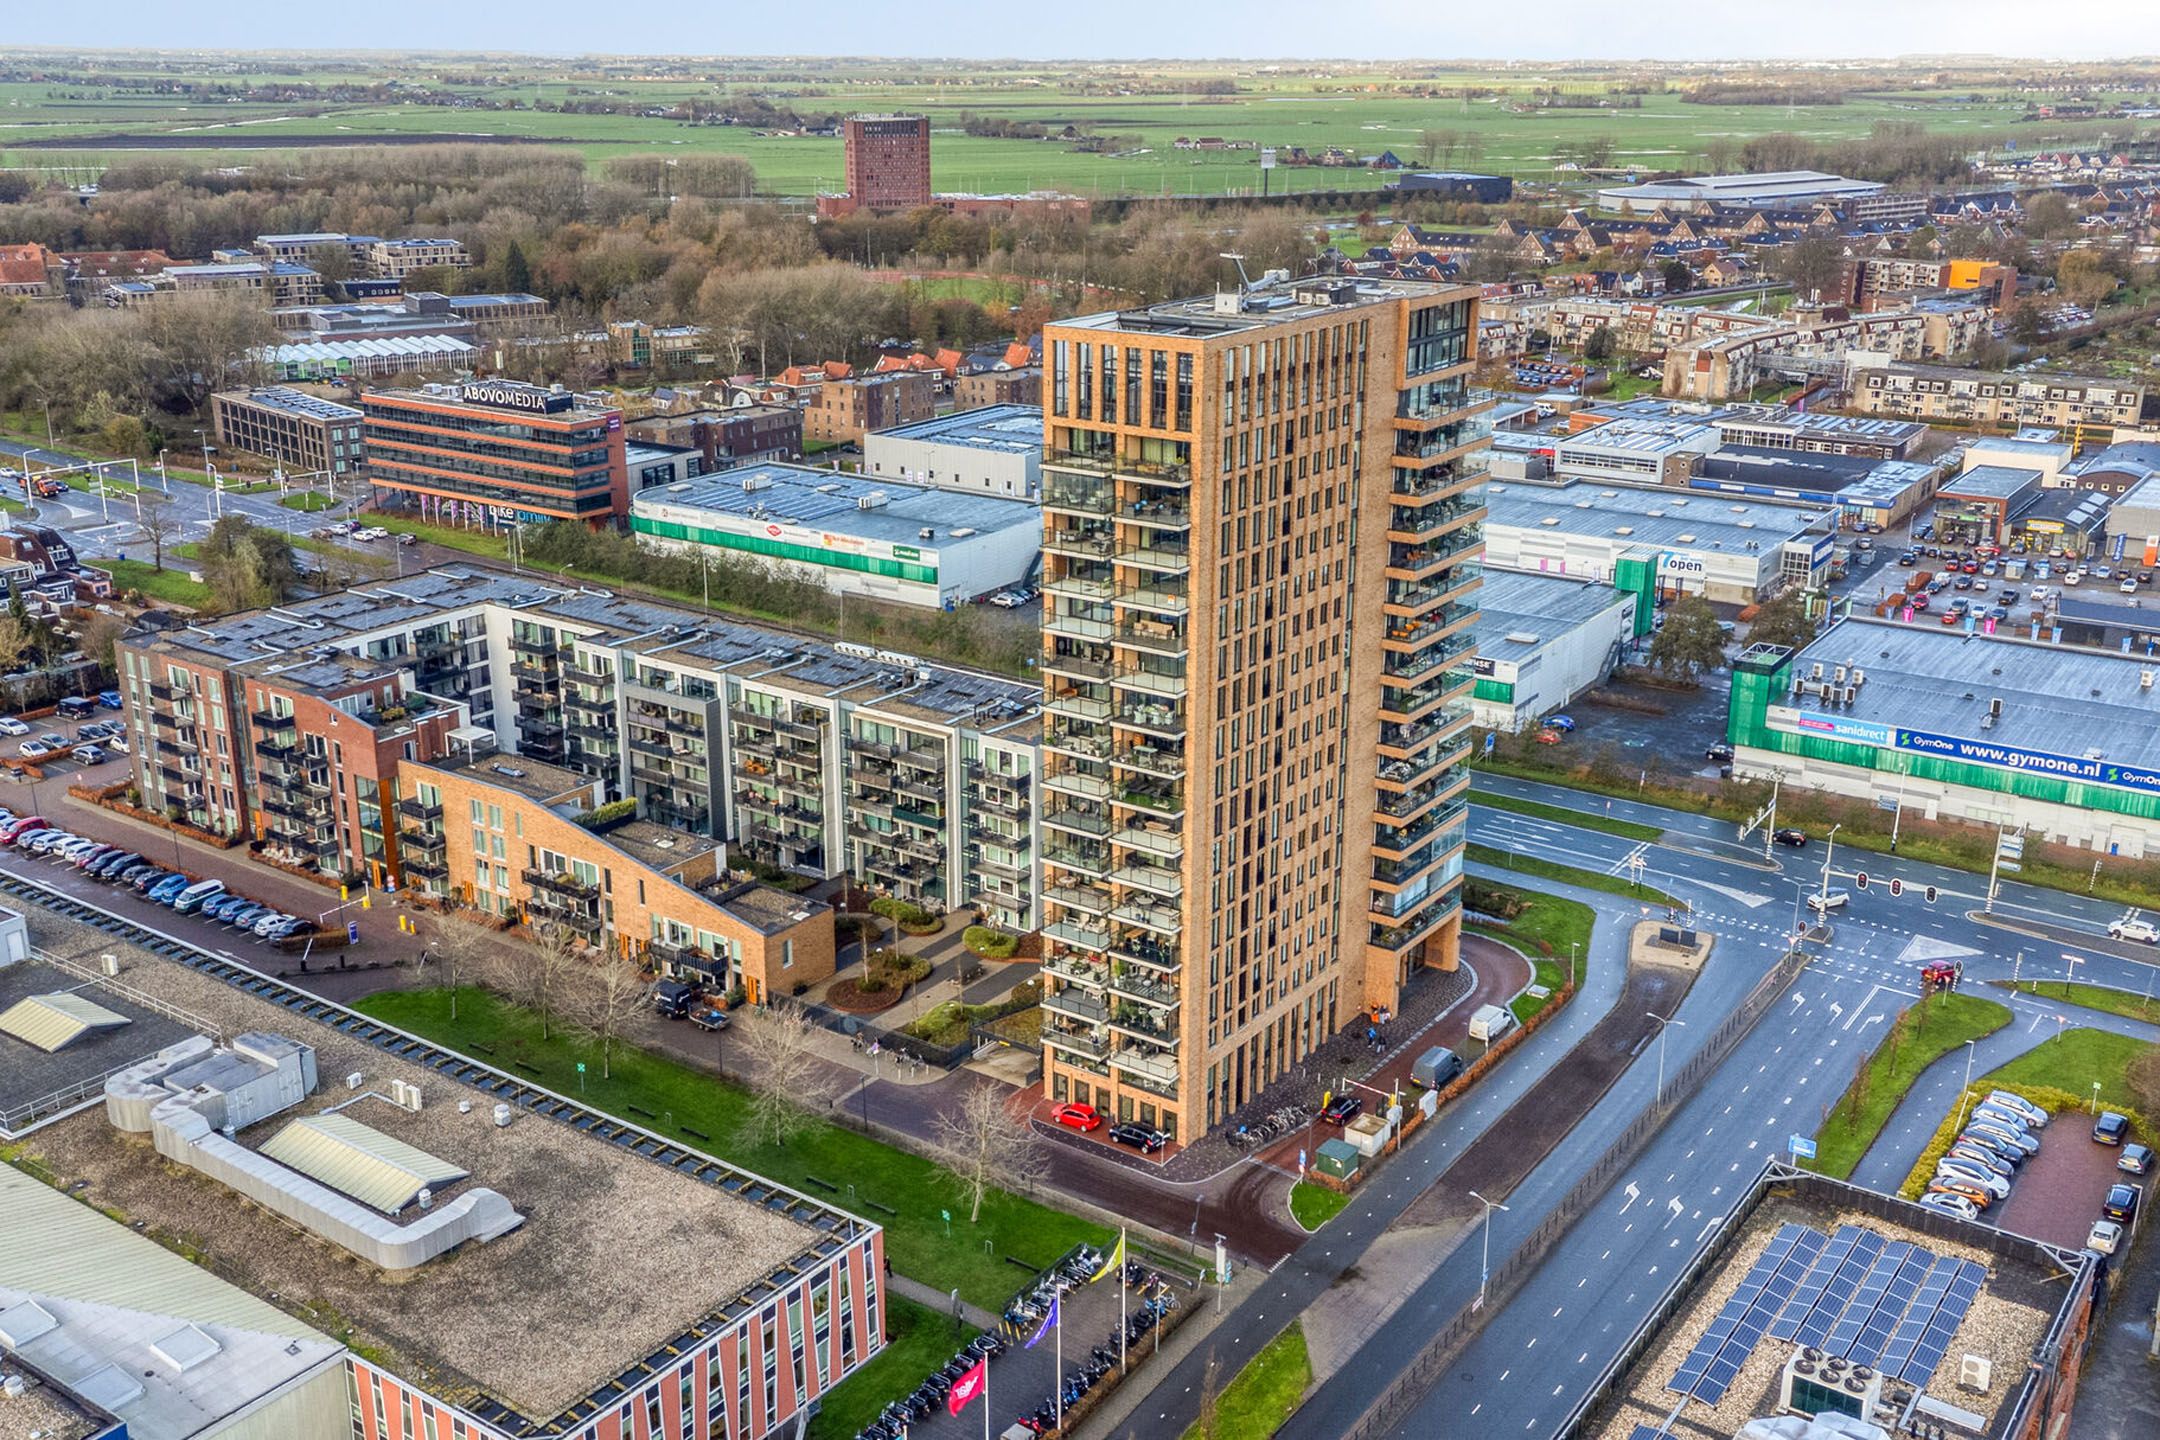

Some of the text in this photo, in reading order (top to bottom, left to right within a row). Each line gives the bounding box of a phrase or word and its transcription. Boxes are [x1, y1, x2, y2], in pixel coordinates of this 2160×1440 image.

[464, 386, 545, 409] ABOVOMEDIA
[1662, 551, 1674, 568] 7
[1670, 560, 1702, 571] open
[1835, 724, 1886, 740] sanidirect
[1913, 736, 2101, 777] GymOne www.gymone.nl
